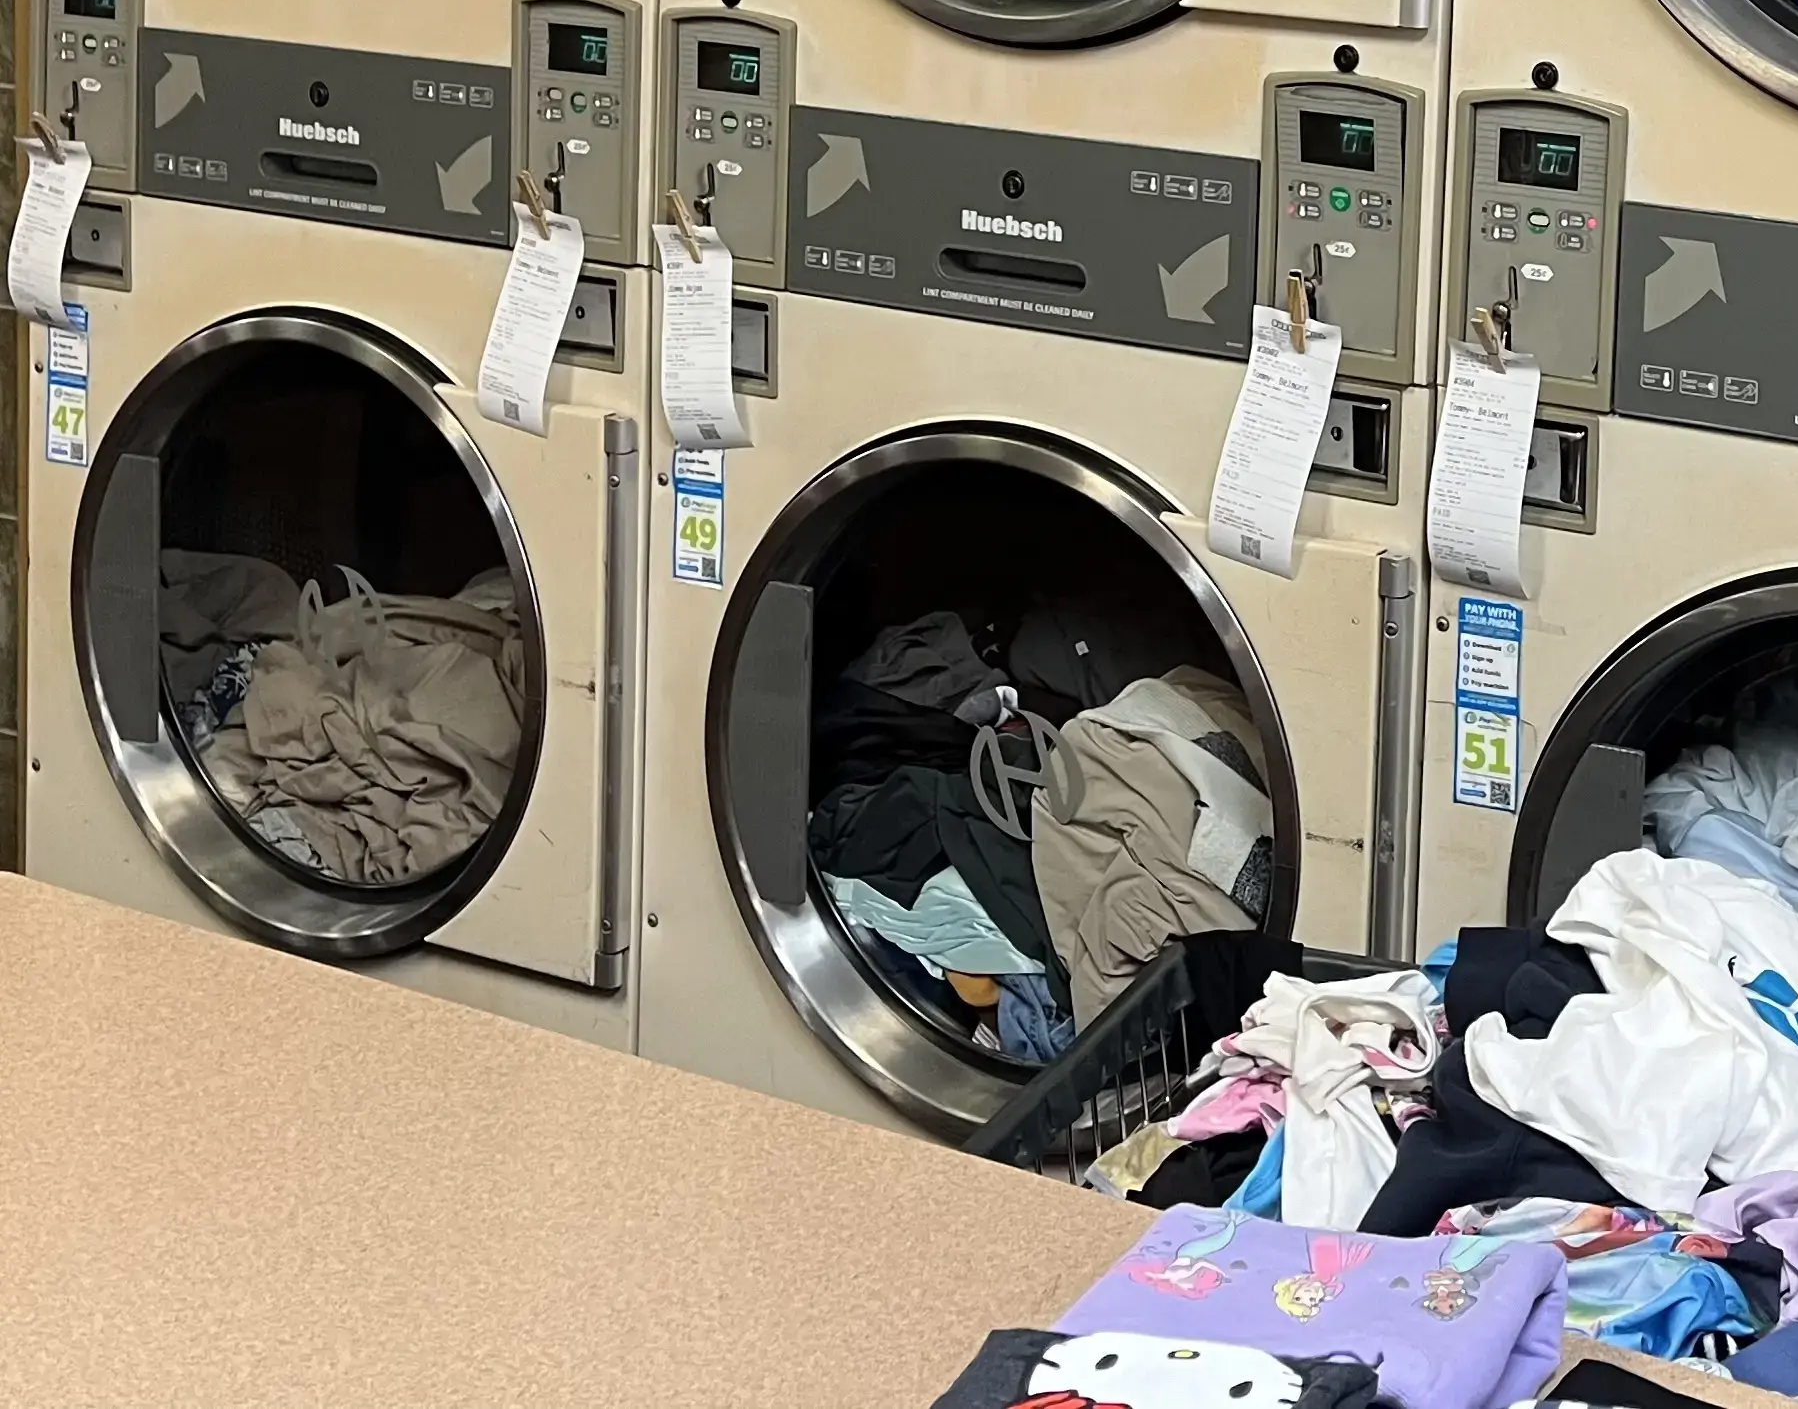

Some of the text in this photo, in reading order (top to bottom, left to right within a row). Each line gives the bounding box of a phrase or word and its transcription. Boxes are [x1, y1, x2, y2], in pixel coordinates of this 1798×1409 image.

[279, 117, 360, 145] Huebsch
[962, 209, 1063, 242] Huebsch
[922, 287, 1094, 320] LINT COMPARTMENT MUST BE CLEANED DAILY
[52, 405, 84, 436] 47
[680, 516, 717, 551] 49
[1465, 603, 1517, 621] PAY WITH
[1462, 731, 1510, 775] 51
